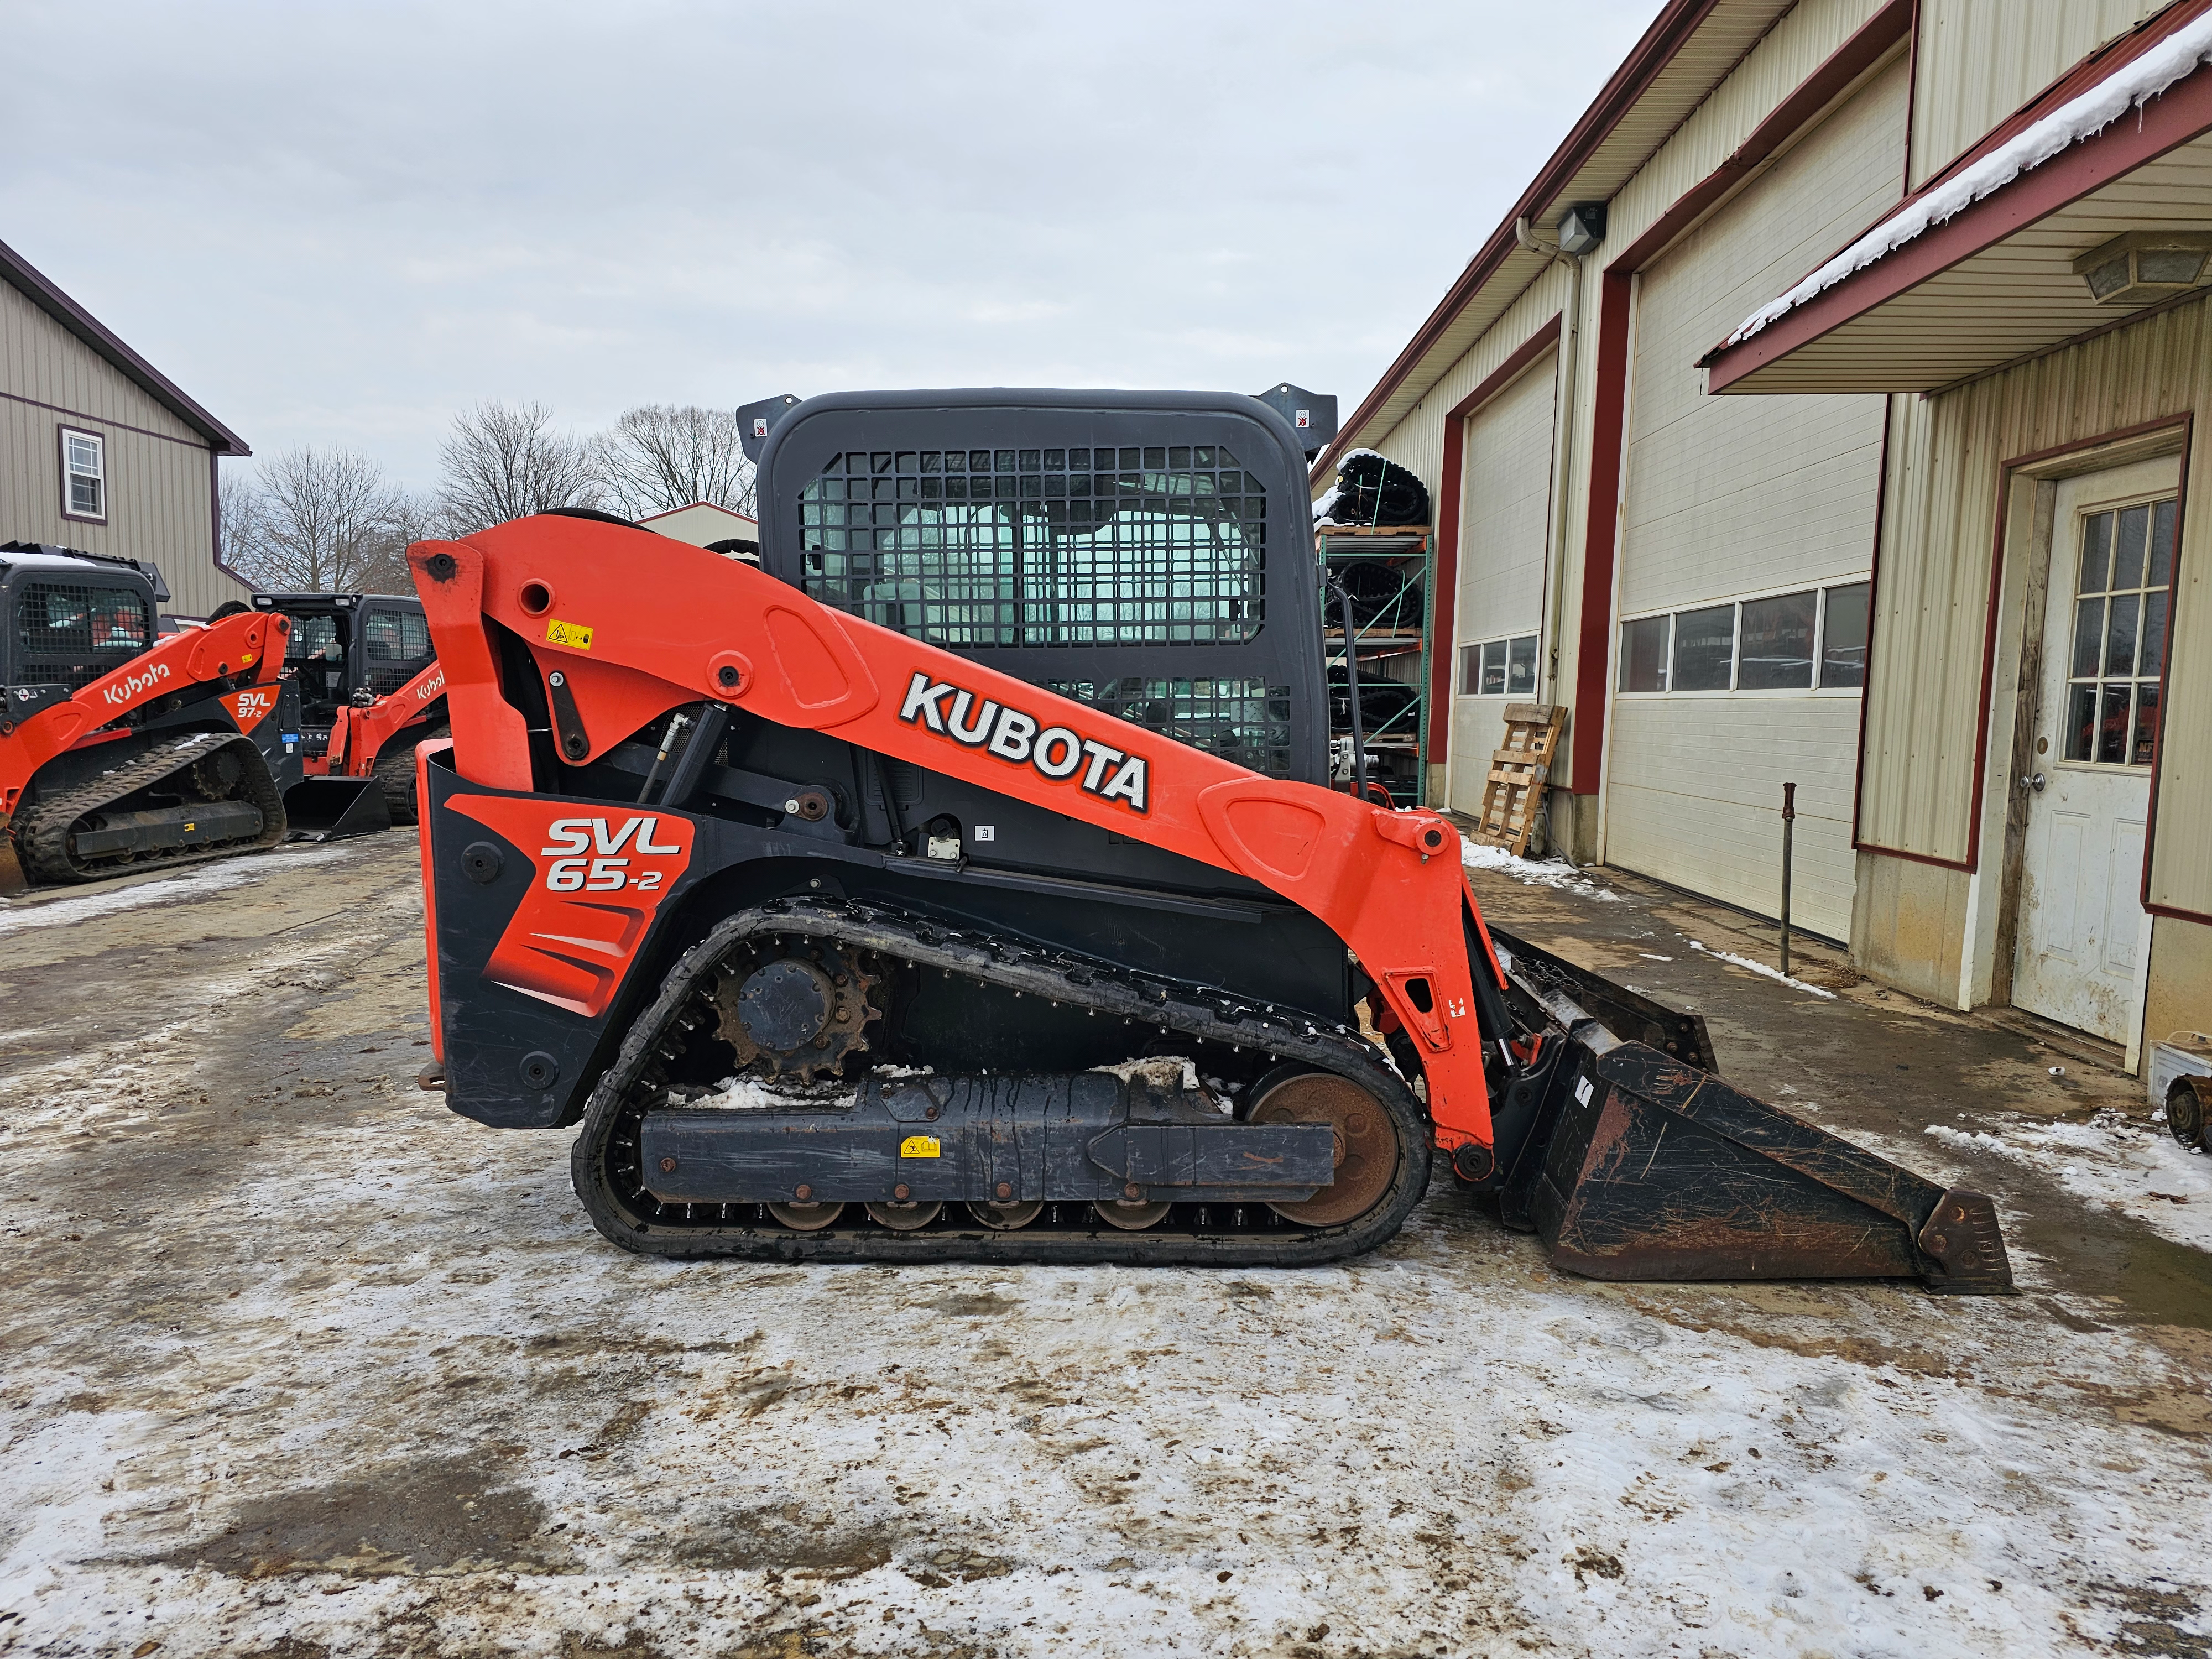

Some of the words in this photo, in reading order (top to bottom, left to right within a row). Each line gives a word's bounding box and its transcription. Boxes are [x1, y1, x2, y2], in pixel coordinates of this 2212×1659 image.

[103, 664, 170, 704] Kubota
[237, 693, 271, 706] SVL
[416, 670, 445, 700] Kubot
[238, 707, 262, 718] 97-2
[900, 672, 1146, 810] KUBOTA
[541, 817, 681, 856] SVL
[546, 858, 663, 891] 65-2
